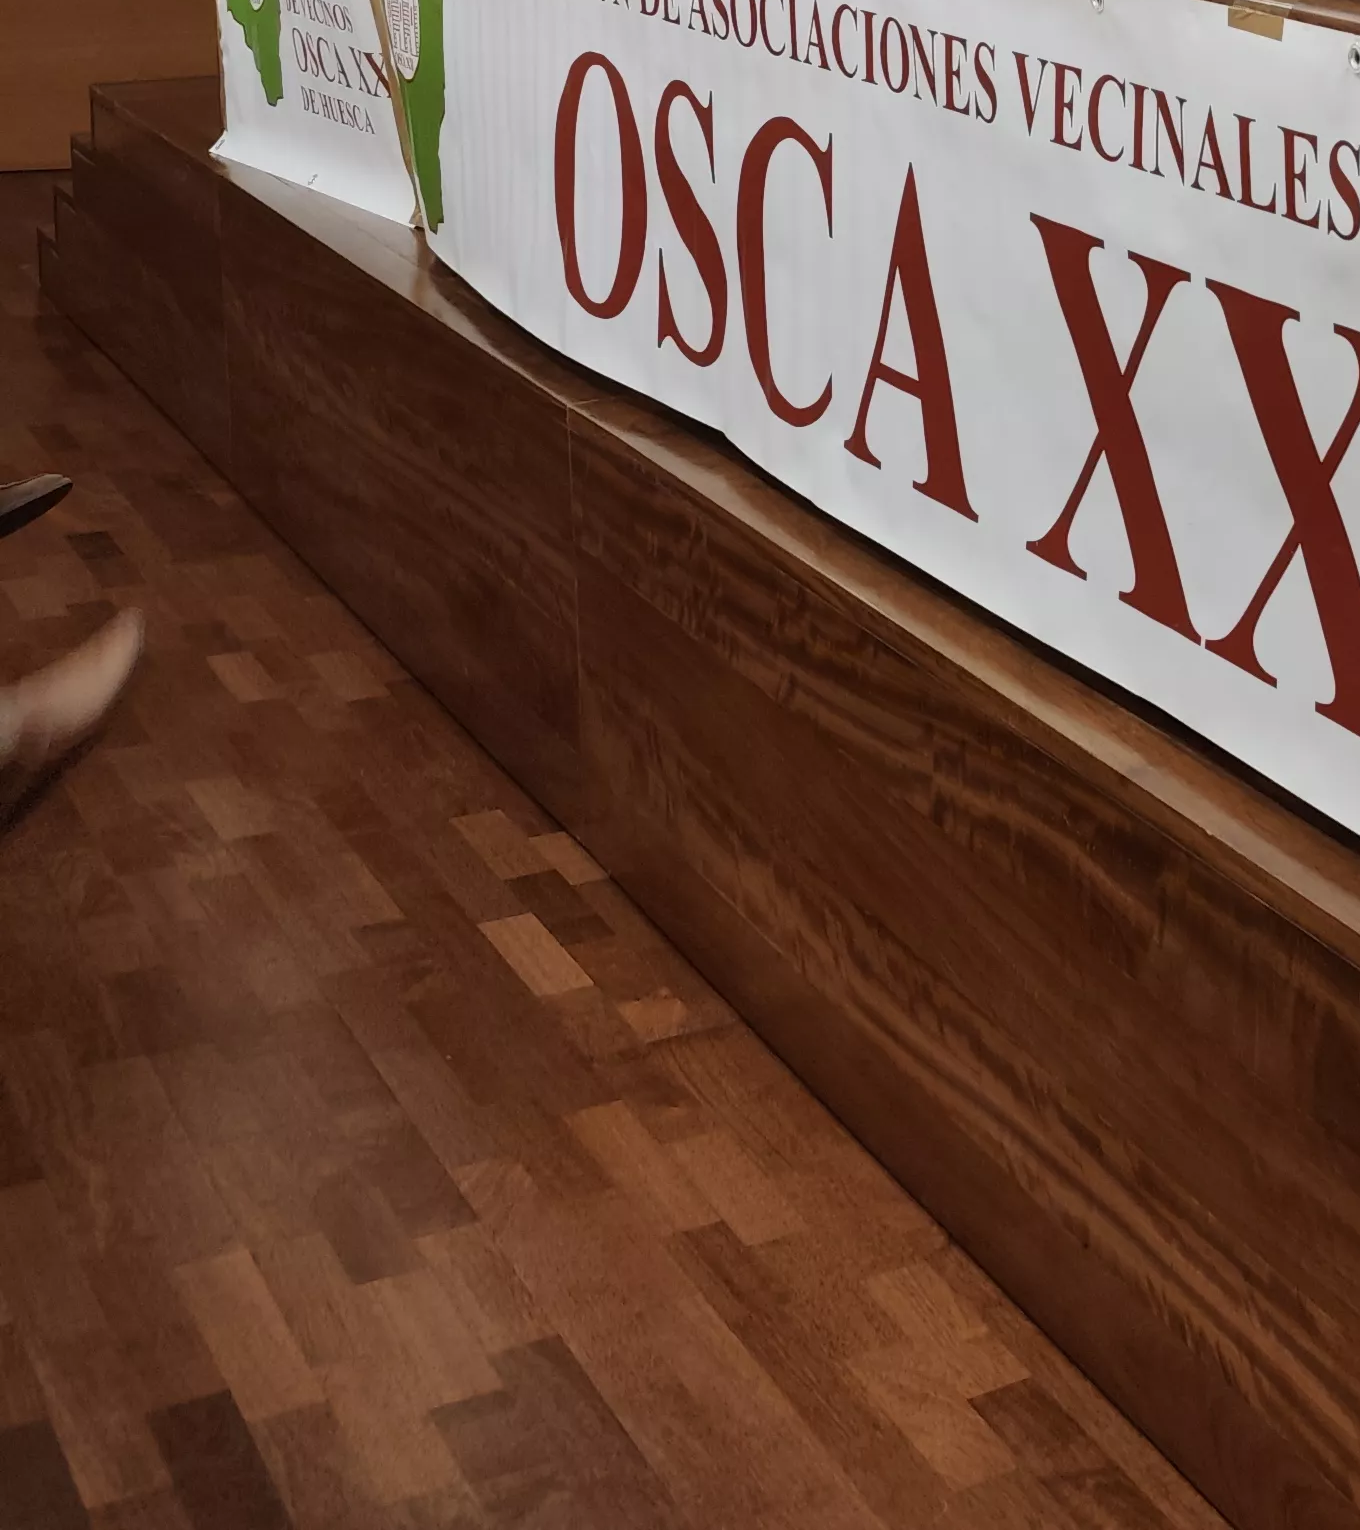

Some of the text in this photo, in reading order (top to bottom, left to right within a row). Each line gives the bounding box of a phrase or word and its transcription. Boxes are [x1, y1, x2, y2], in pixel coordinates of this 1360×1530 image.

[292, 27, 353, 89] OSCA
[300, 85, 376, 135] DE HUESCA
[554, 50, 979, 523] OSCA
